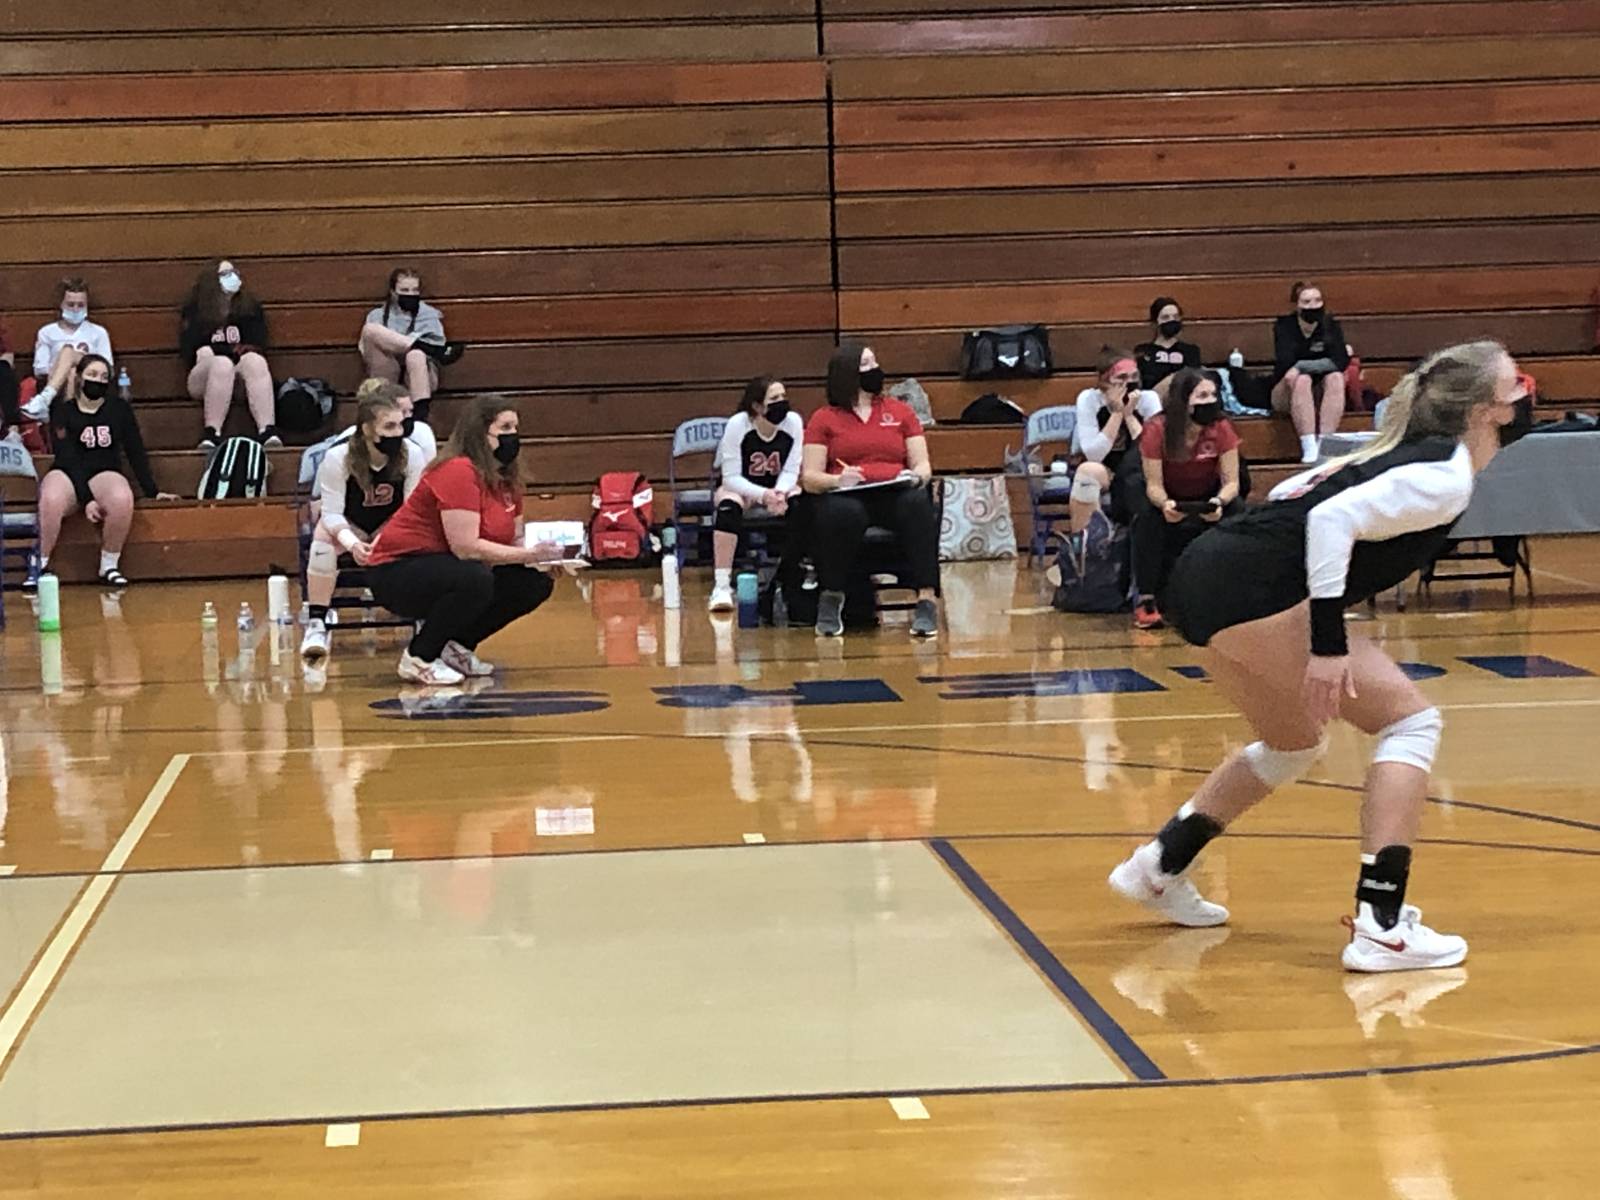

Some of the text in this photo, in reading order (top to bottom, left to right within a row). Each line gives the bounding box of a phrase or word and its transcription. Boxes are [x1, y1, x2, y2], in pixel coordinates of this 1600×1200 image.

[1037, 411, 1077, 433] TIGE
[80, 425, 112, 448] 45
[748, 451, 781, 477] 24
[362, 483, 395, 508] 12
